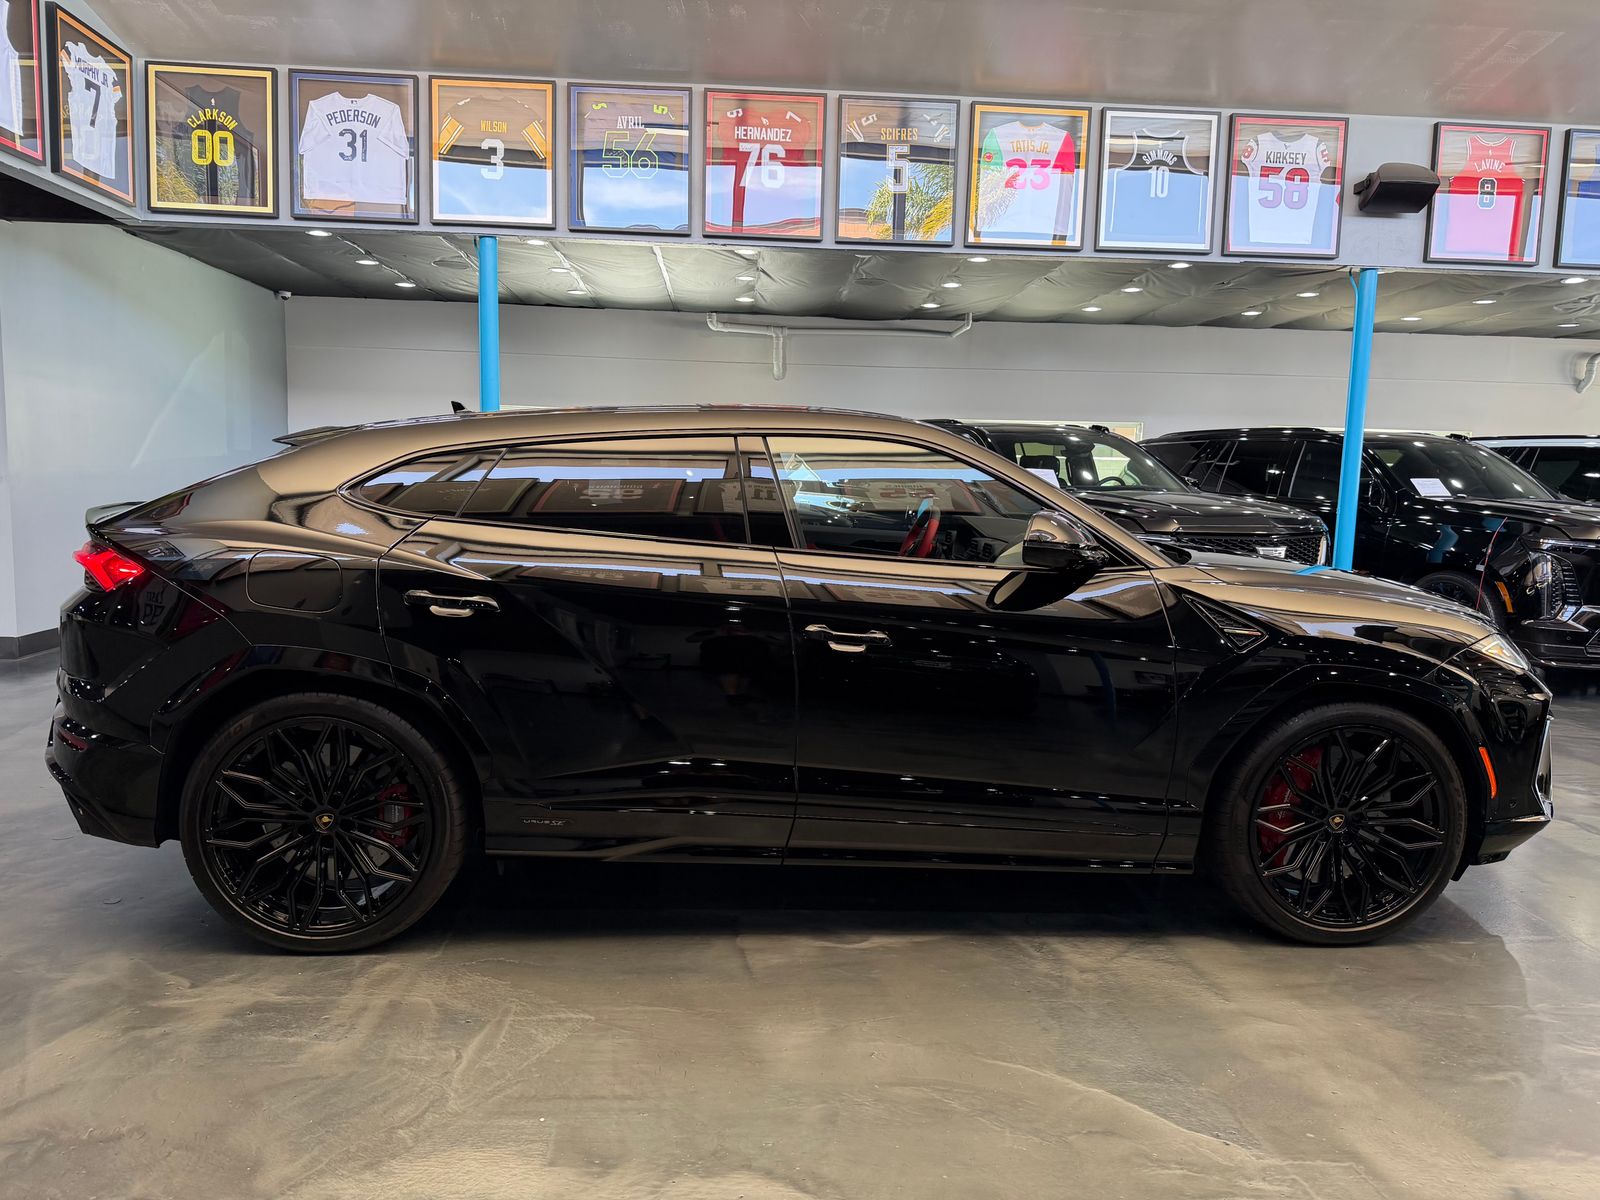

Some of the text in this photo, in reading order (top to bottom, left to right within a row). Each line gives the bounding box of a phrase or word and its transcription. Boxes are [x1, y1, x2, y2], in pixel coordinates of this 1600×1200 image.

[84, 78, 101, 128] 7
[326, 109, 381, 128] PEDERSON
[187, 108, 238, 131] CLARKSON
[480, 120, 507, 133] WILSON
[616, 116, 644, 128] AVRIL
[734, 126, 792, 142] HERNANDEZ
[880, 128, 918, 141] SCIFRES
[191, 129, 235, 167] 00
[338, 128, 367, 162] 31
[480, 138, 505, 180] 3
[602, 130, 659, 179] 56
[1265, 151, 1307, 165] KIRKSEY
[739, 142, 786, 189] 76
[886, 144, 911, 194] 5
[1004, 158, 1052, 190] 23
[1474, 158, 1506, 172] LAVINE
[1149, 165, 1170, 198] 10
[1258, 165, 1310, 209] 58
[1477, 177, 1498, 209] 8
